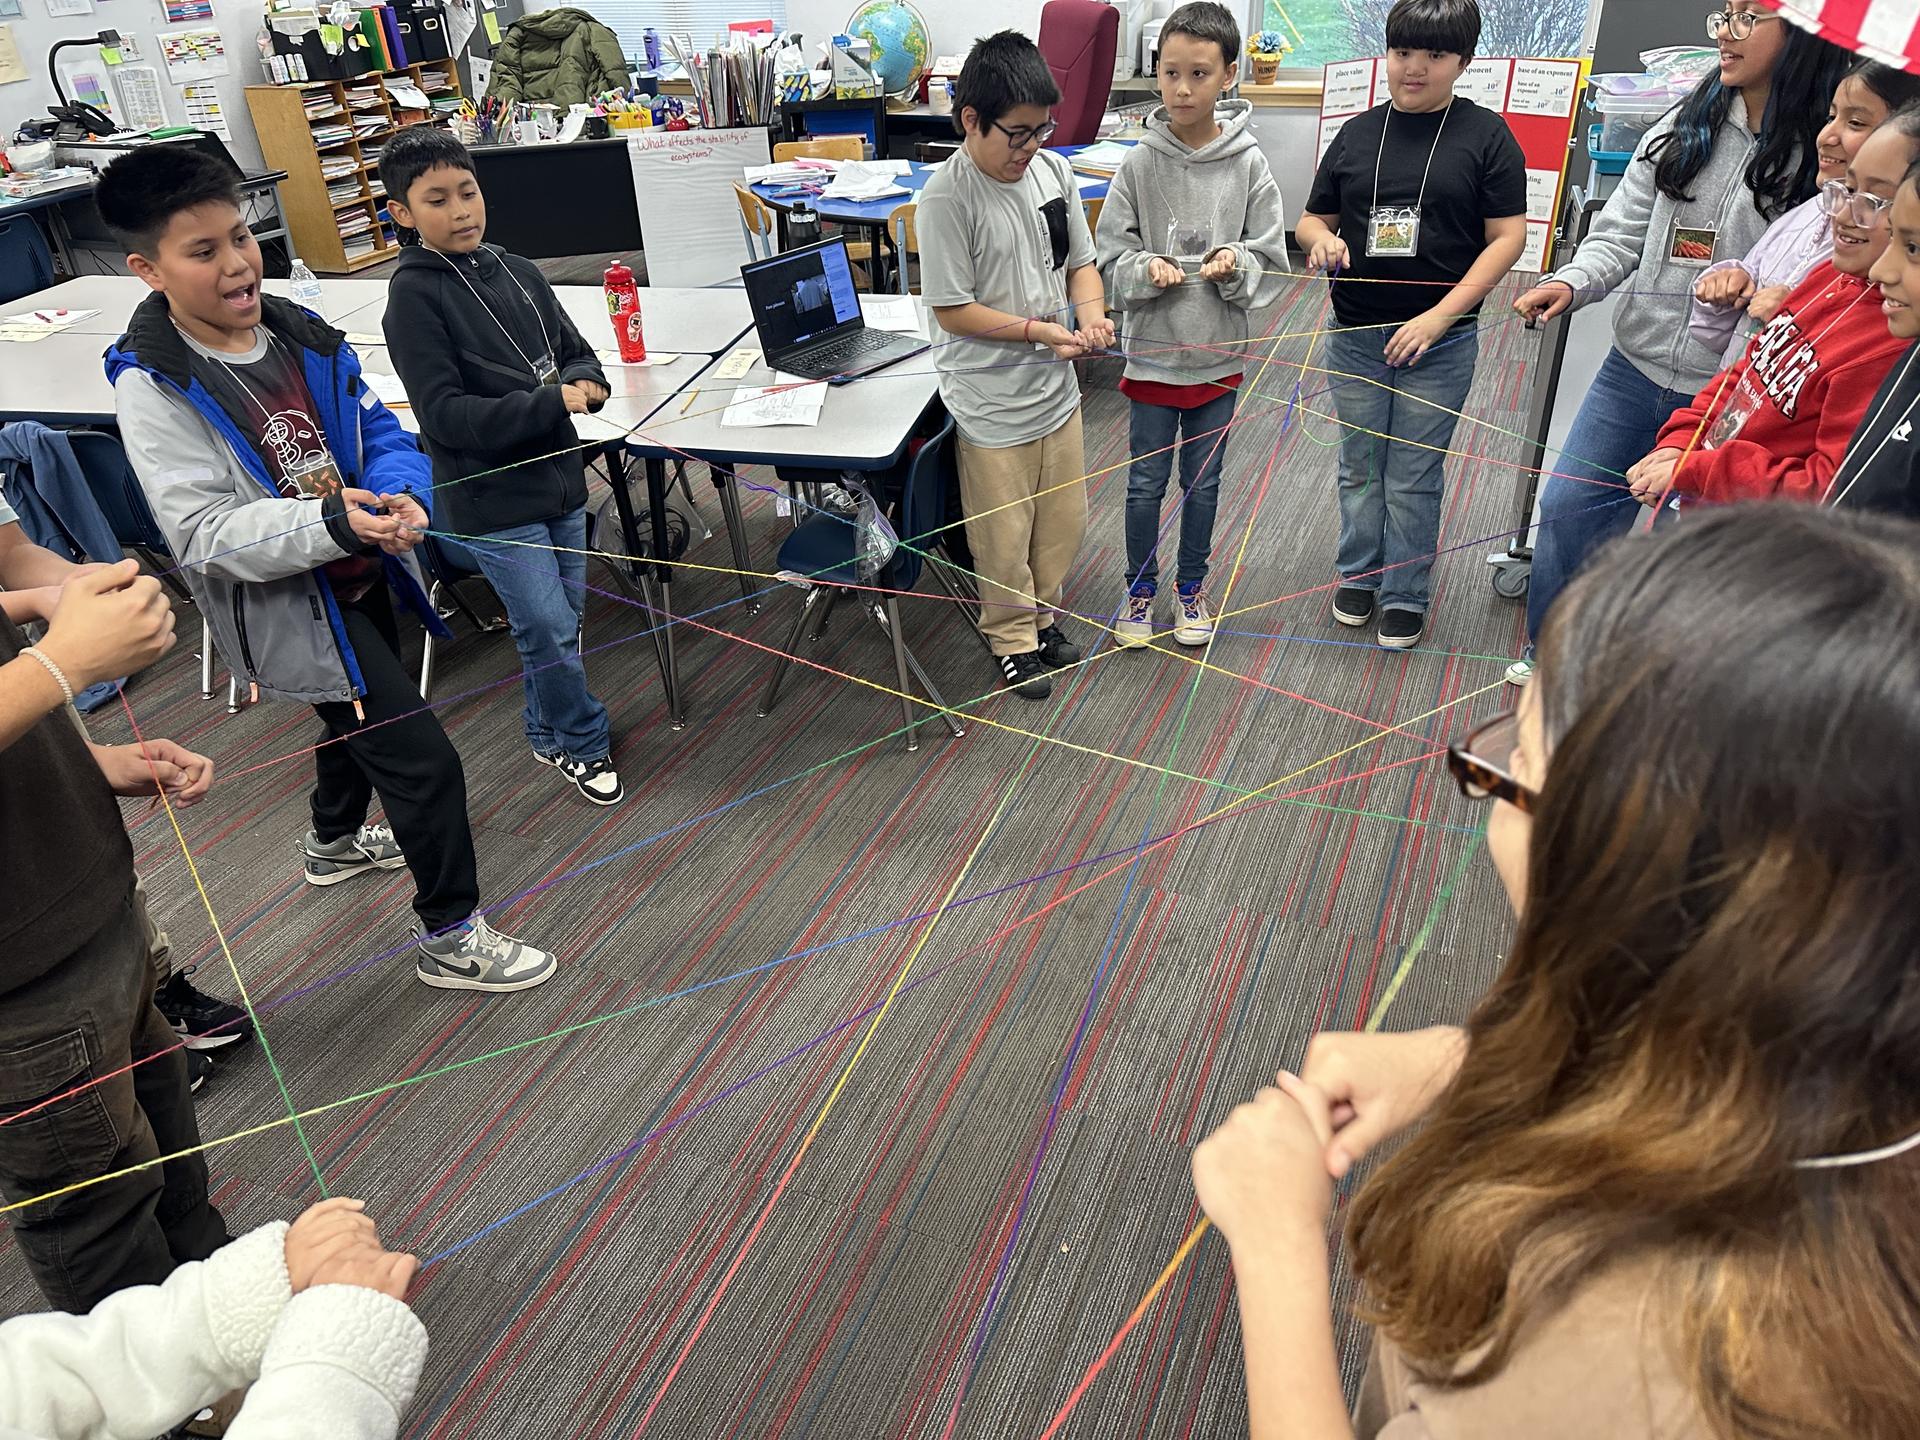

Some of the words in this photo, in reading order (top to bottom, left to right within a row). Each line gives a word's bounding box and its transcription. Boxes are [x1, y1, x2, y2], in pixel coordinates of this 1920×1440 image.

[636, 136, 665, 151] What
[694, 134, 706, 144] the
[708, 132, 740, 146] stability
[741, 131, 749, 141] of
